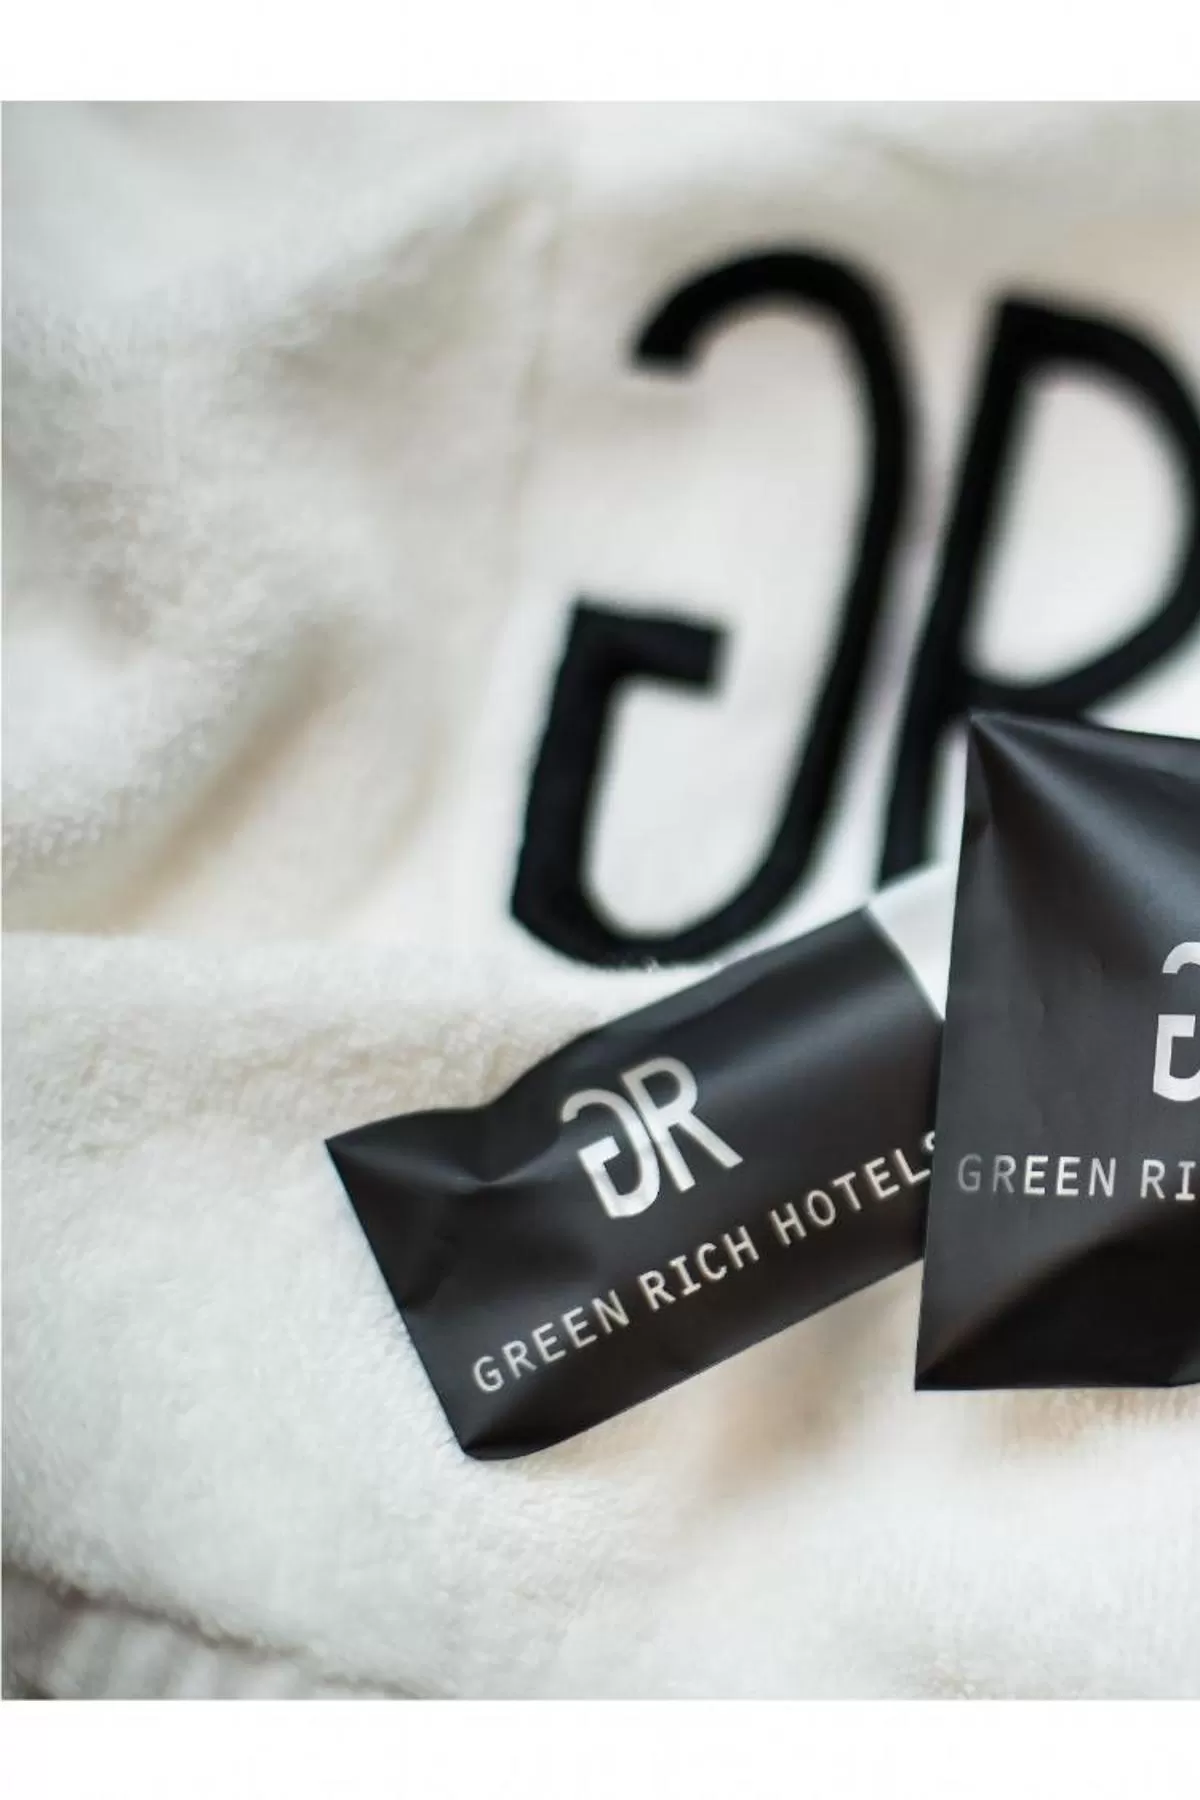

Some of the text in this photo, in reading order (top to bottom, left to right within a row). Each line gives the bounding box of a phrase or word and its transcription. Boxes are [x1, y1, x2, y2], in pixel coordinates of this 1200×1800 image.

[957, 1153, 1117, 1197] GREEN
[472, 1291, 630, 1393] GREEN
[638, 1225, 761, 1312] RICH
